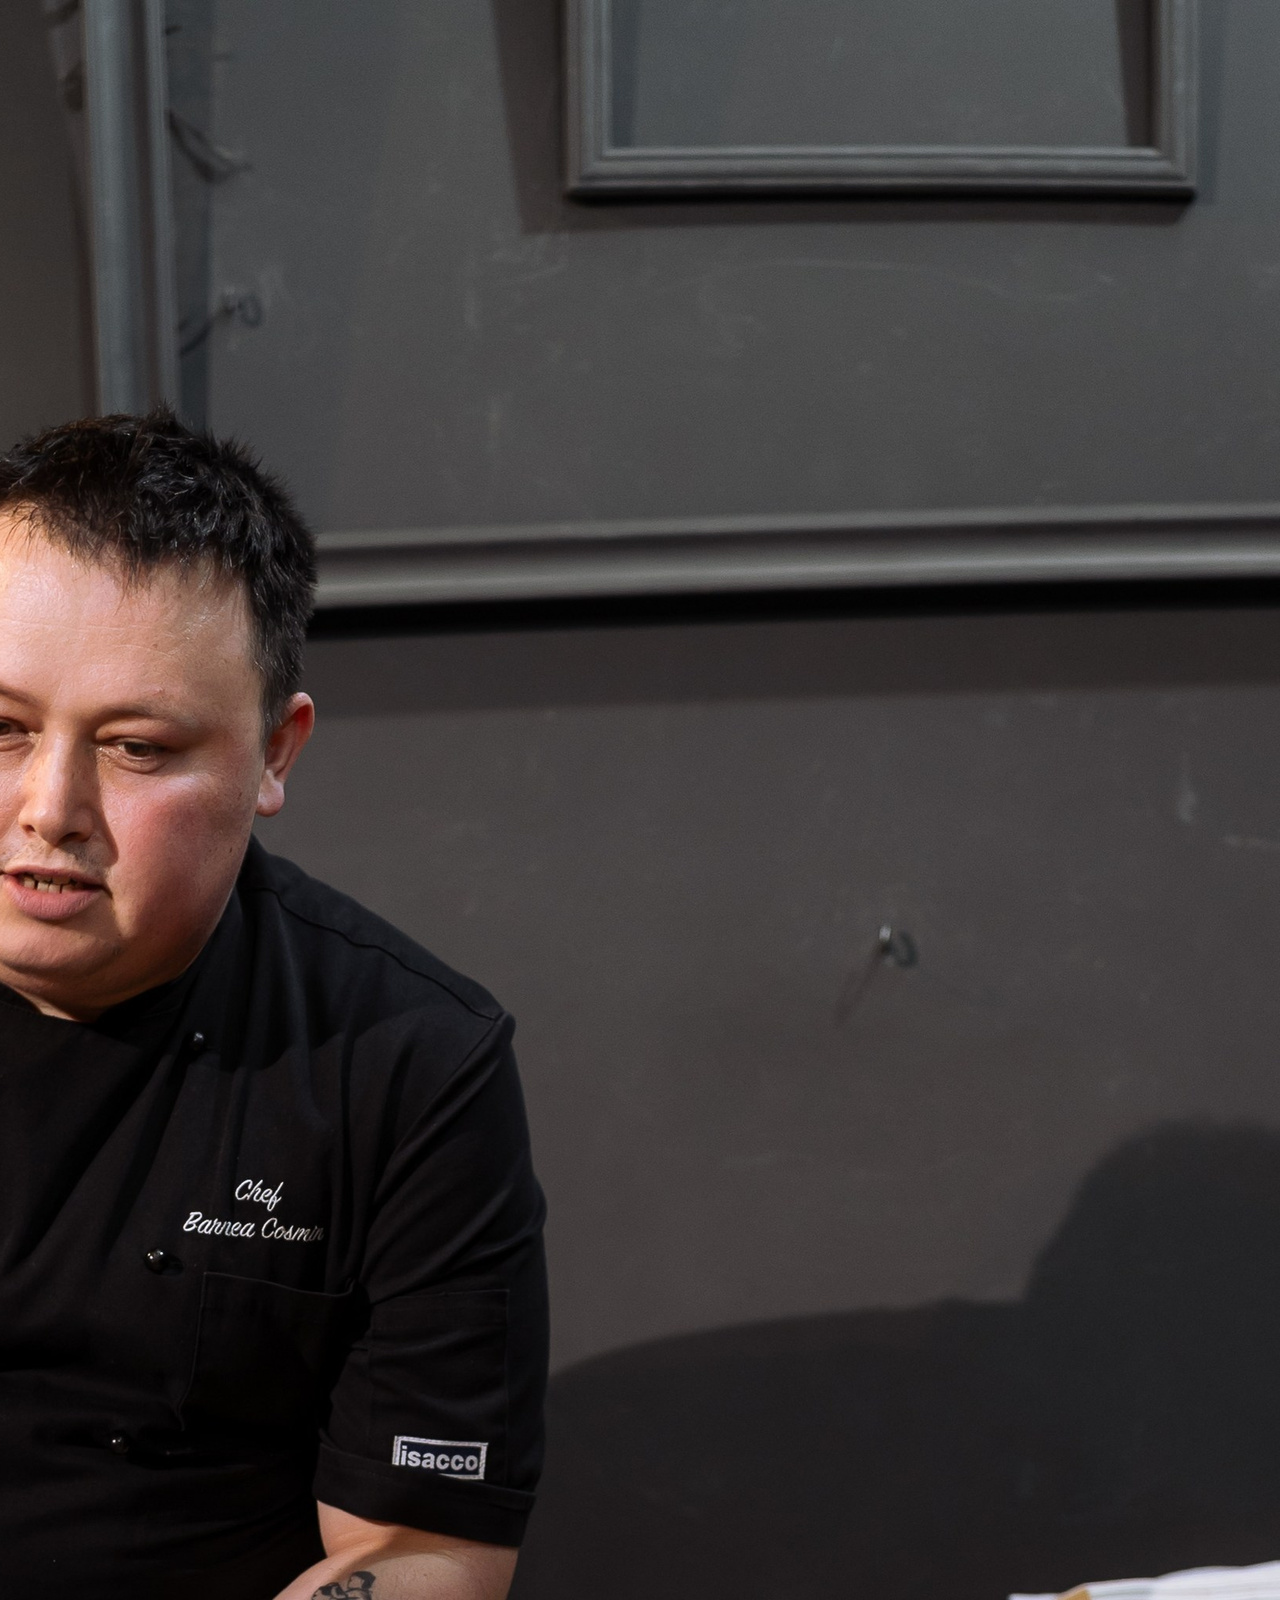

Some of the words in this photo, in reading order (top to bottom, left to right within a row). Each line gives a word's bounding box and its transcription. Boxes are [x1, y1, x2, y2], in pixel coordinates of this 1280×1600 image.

[235, 1179, 284, 1212] Chef
[183, 1211, 255, 1238] Barnea
[400, 1445, 478, 1471] isacco
